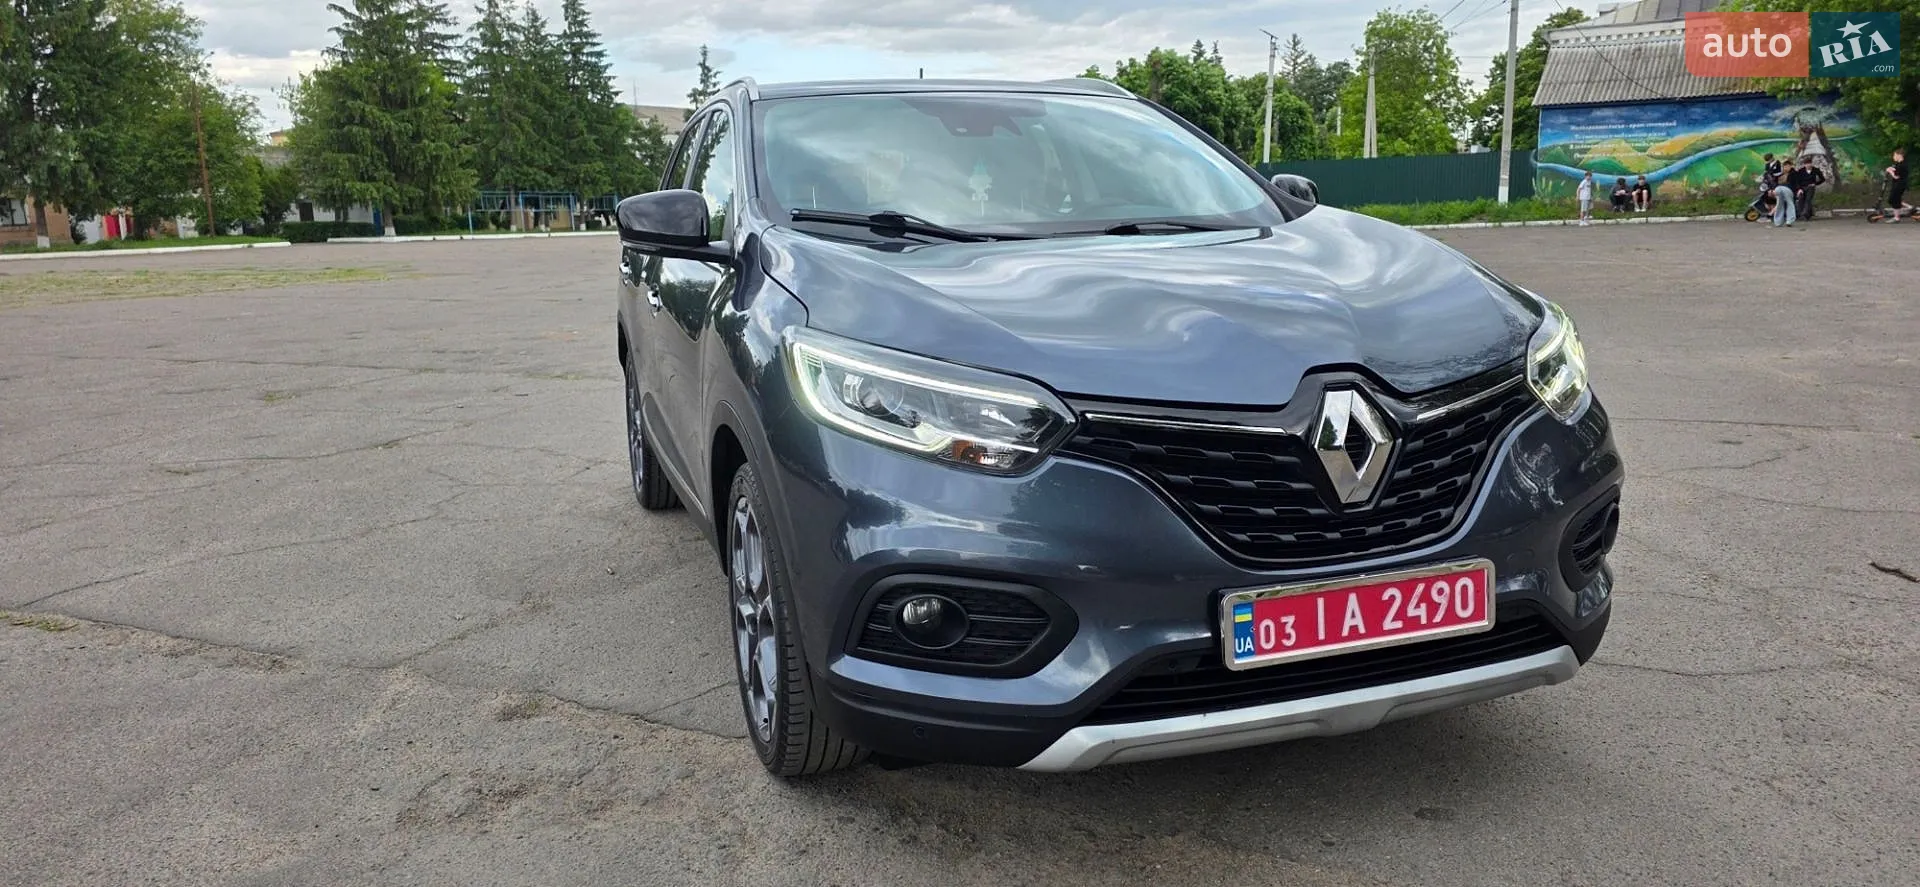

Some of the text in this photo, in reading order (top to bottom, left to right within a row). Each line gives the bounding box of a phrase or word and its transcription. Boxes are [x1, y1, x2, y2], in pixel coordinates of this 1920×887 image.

[1259, 577, 1475, 650] 03 IA 2490
[1235, 637, 1254, 654] UA
